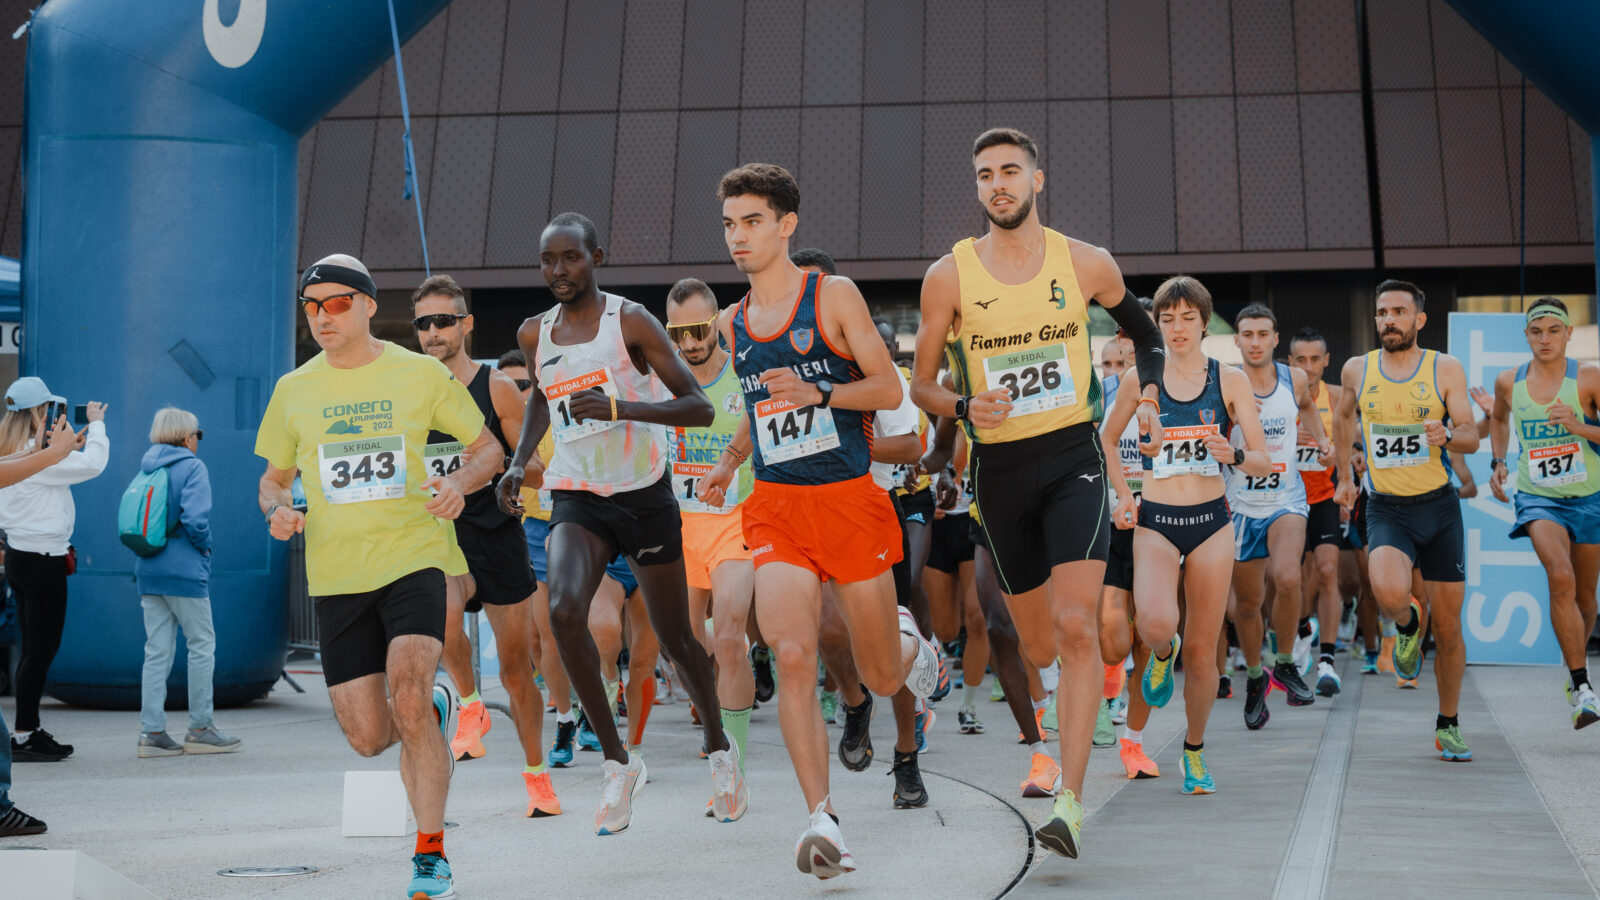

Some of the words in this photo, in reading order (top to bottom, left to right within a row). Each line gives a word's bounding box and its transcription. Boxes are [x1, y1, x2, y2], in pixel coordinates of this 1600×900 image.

[970, 332, 1032, 351] Fiamme
[1038, 321, 1079, 342] Gialle
[1007, 357, 1019, 365] 5K
[1021, 351, 1047, 362] FIDAL
[560, 374, 602, 393] FIDAL-FSAL
[999, 360, 1062, 402] 326
[372, 421, 393, 430] 2022
[767, 404, 815, 447] 147
[1263, 417, 1287, 426] AMO
[344, 445, 355, 453] 5K
[356, 442, 382, 451] FIDAL
[1163, 438, 1208, 465] 148
[1375, 434, 1421, 458] 345
[331, 451, 396, 489] 343
[431, 455, 461, 477] 34
[1537, 453, 1574, 478] 137
[1245, 472, 1280, 491] 123
[1467, 329, 1542, 648] STAT
[1155, 512, 1214, 526] CARABINIERI
